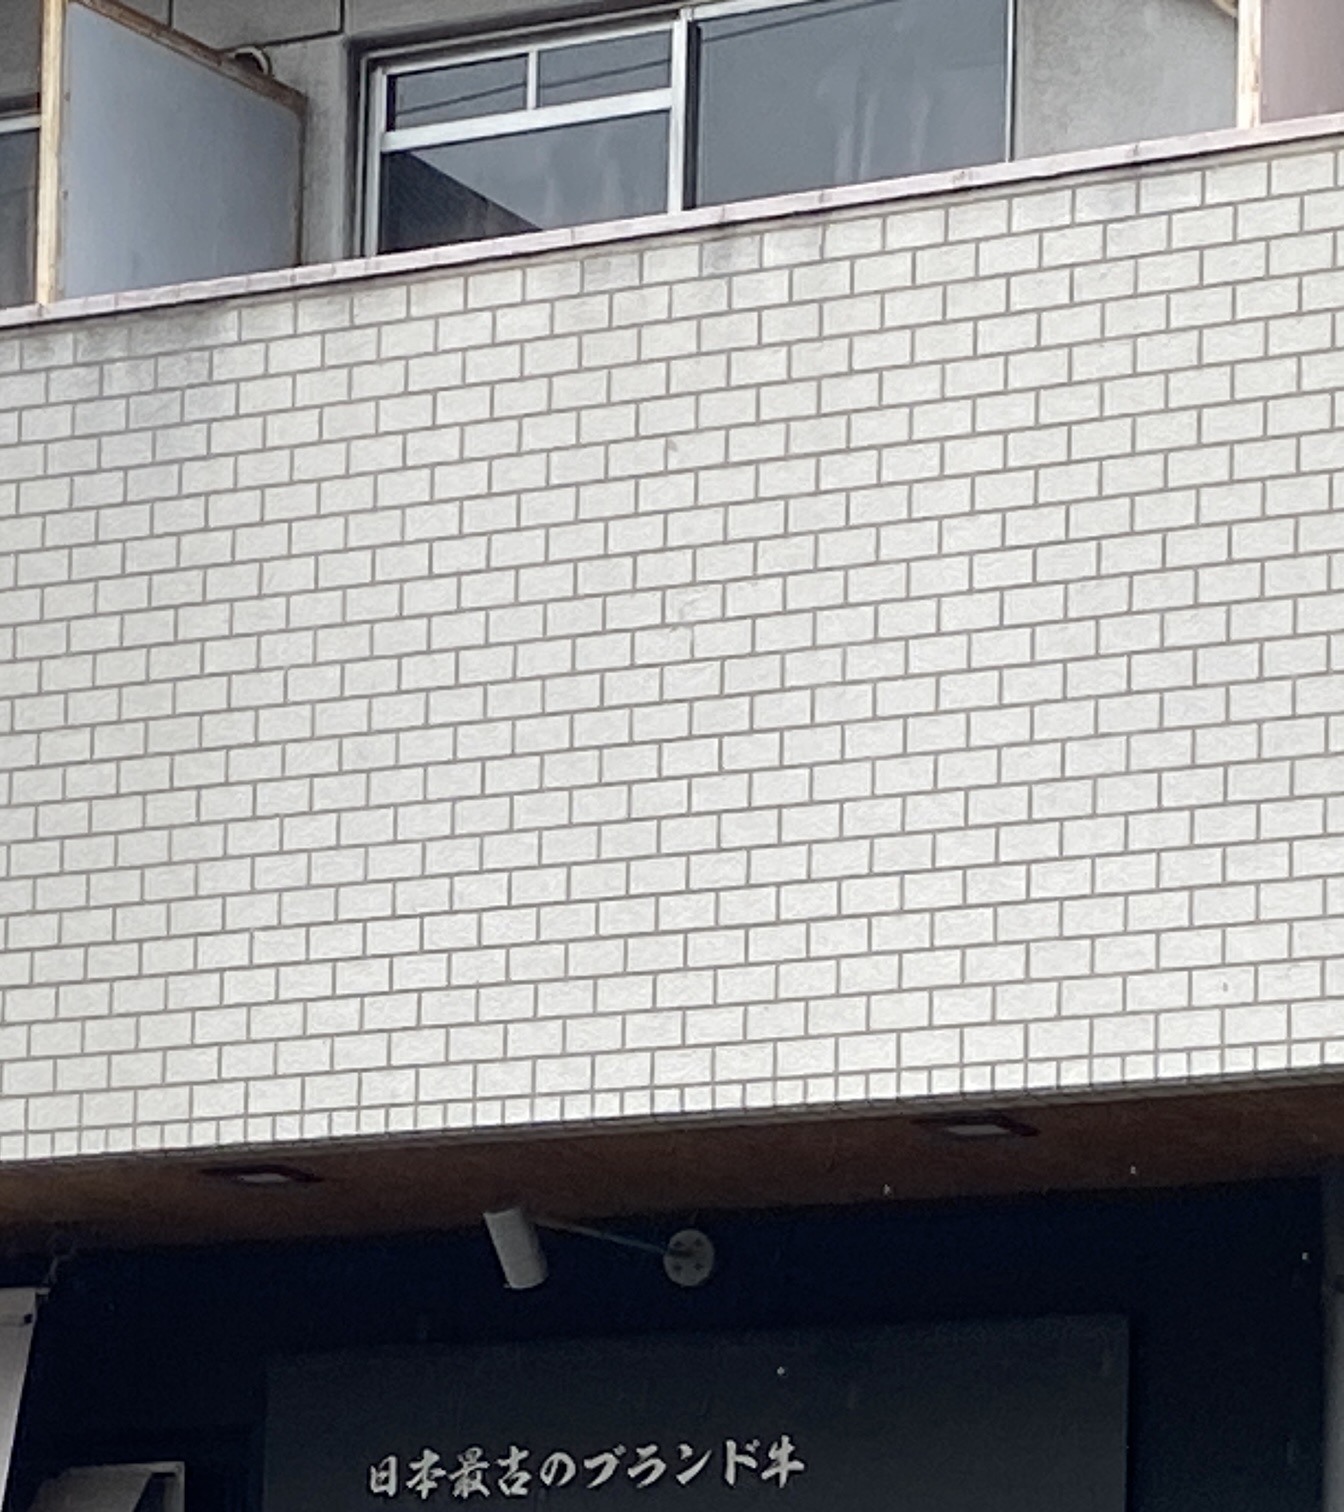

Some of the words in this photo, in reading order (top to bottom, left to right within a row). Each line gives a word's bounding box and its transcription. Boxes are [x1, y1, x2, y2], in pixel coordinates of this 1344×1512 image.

[368, 1434, 805, 1500] 日本最古のブランド牛
